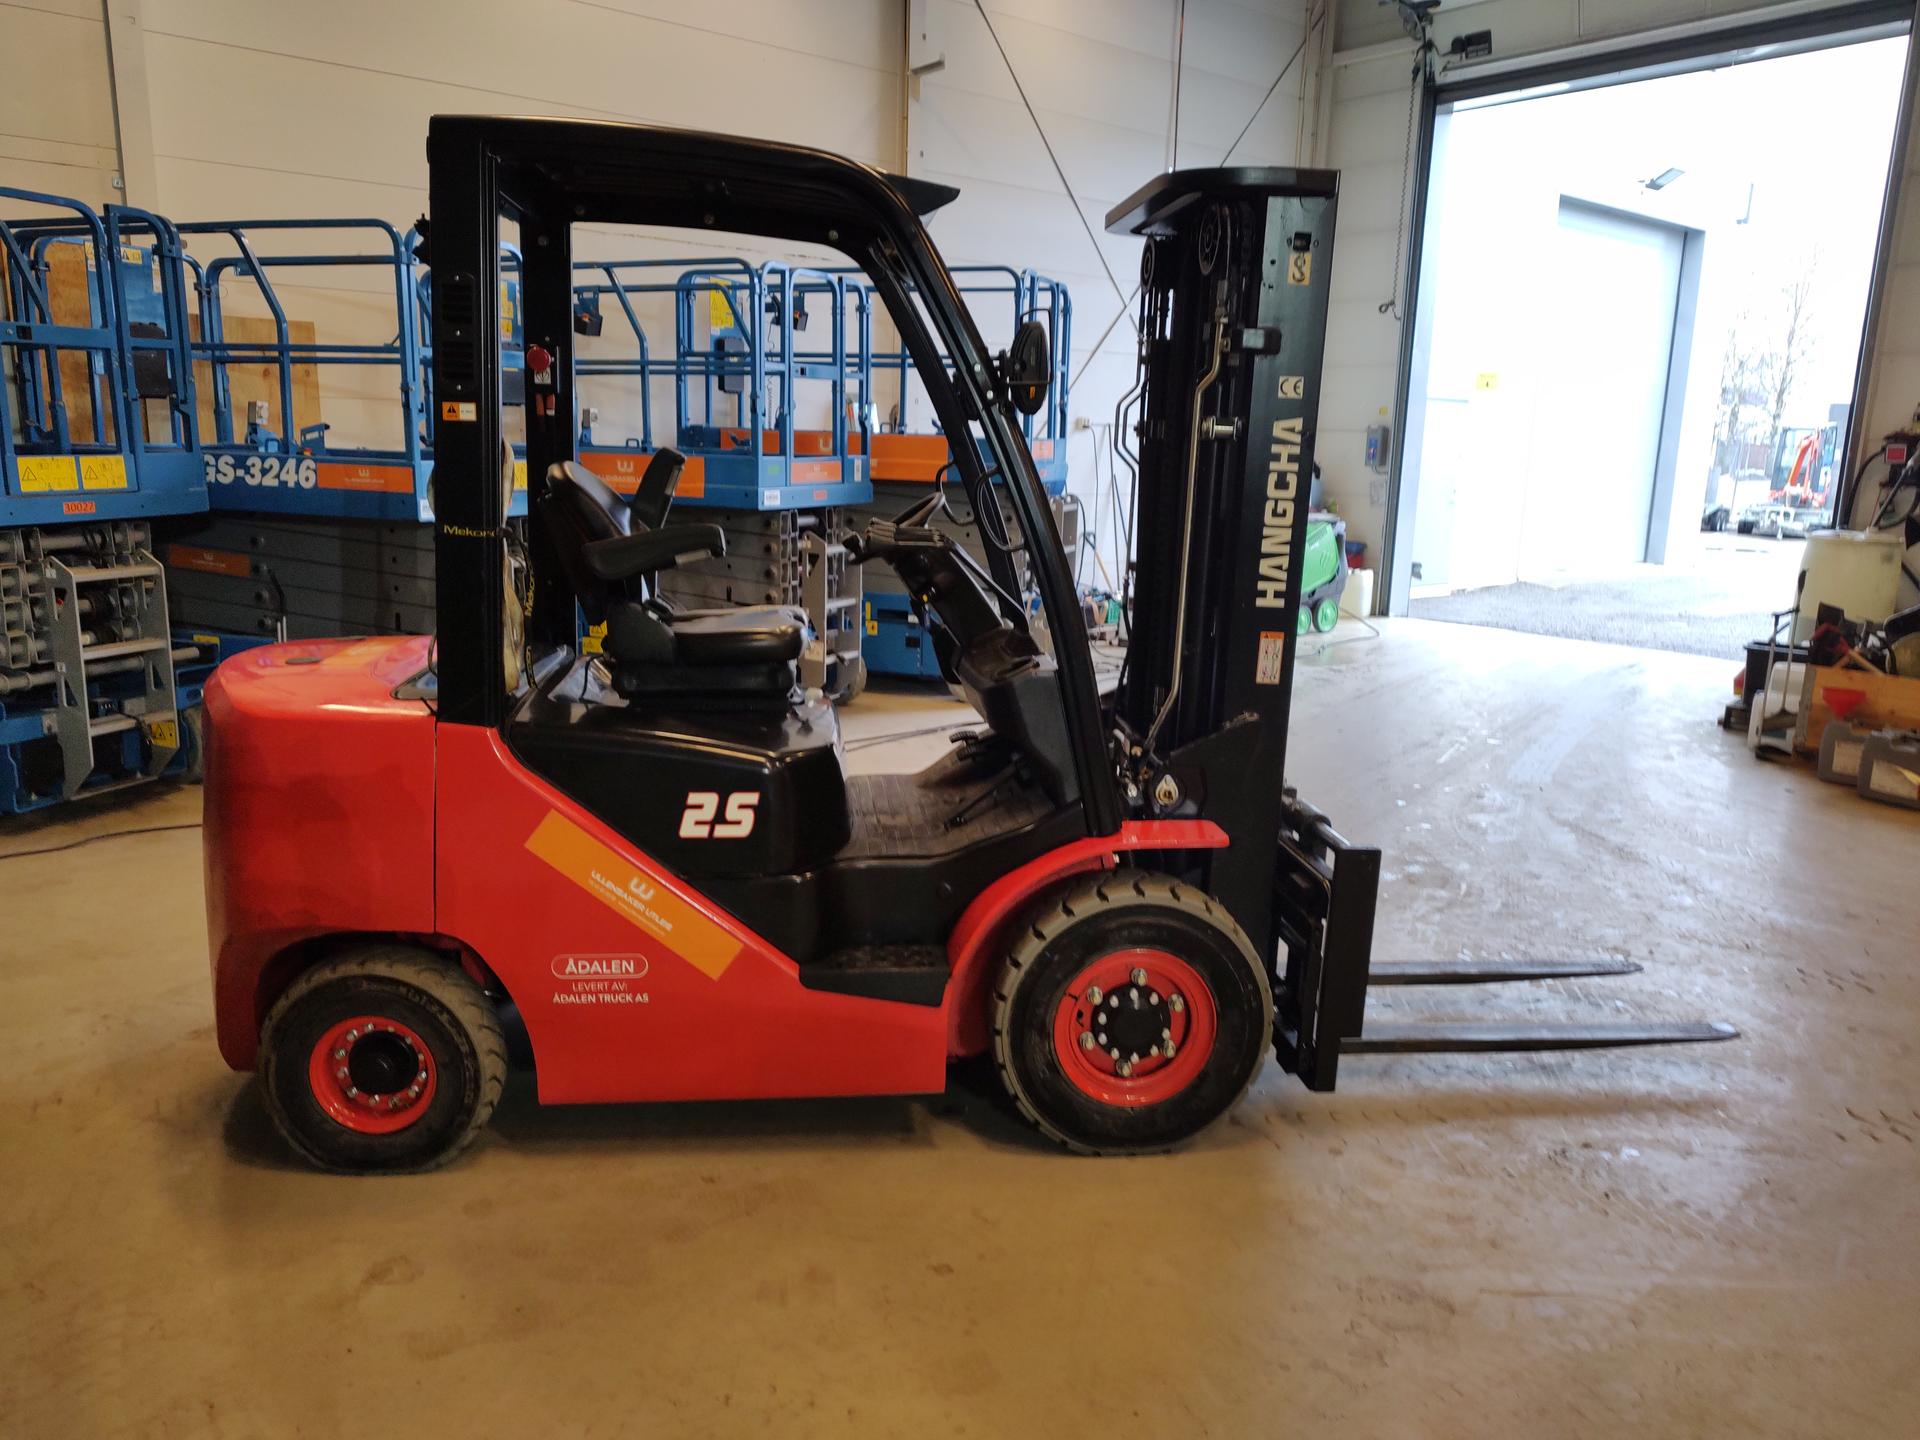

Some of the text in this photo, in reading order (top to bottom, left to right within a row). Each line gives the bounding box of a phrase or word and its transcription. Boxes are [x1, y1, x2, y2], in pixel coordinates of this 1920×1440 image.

[204, 454, 316, 489] GS-3246
[1256, 417, 1303, 608] HANGCHA
[679, 791, 760, 839] 25
[565, 957, 634, 975] ÅDALEN
[552, 991, 596, 1004] ÅDALEN
[598, 993, 633, 1003] TRUCK
[572, 981, 608, 992] LEVERT
